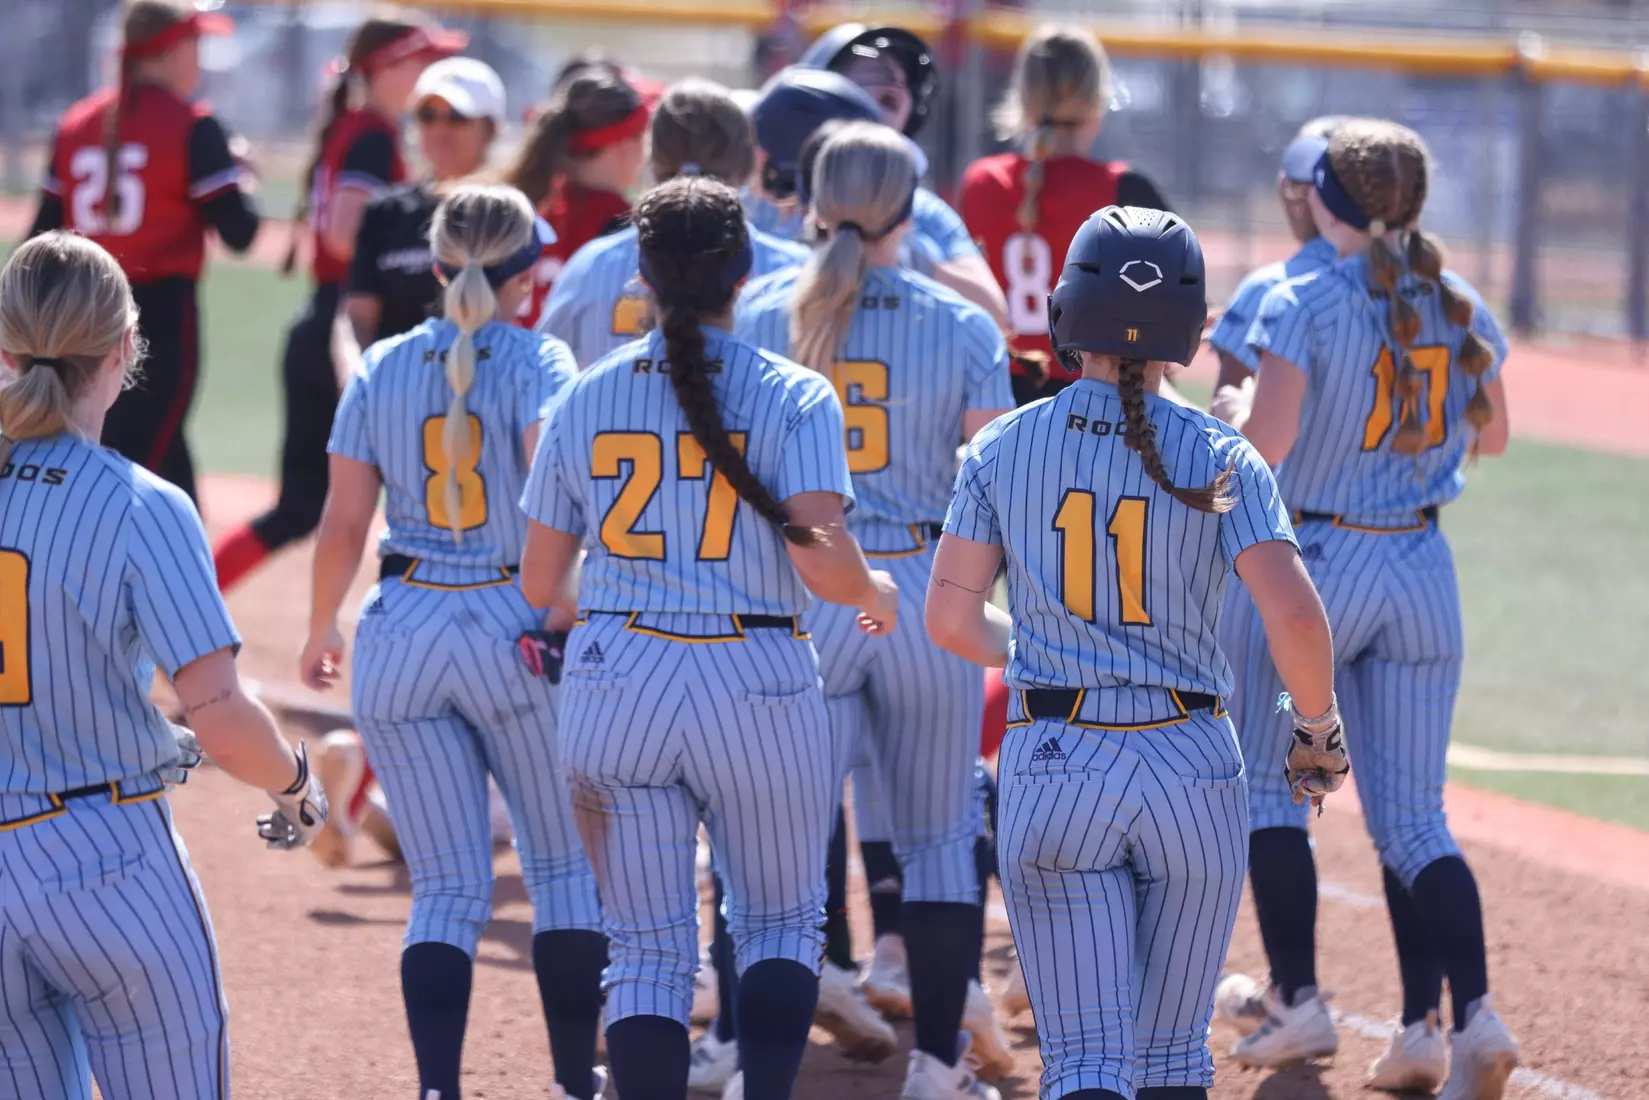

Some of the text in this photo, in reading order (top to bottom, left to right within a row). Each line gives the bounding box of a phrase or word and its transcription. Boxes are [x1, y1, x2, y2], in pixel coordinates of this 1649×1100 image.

[1003, 232, 1052, 335] 8
[1127, 329, 1137, 341] 11
[423, 347, 492, 362] ROS
[633, 358, 724, 374] ROS
[832, 360, 889, 473] 6
[423, 412, 488, 531] 8
[588, 430, 749, 562] 27
[1050, 487, 1154, 627] 11
[1032, 751, 1067, 761] adidas
